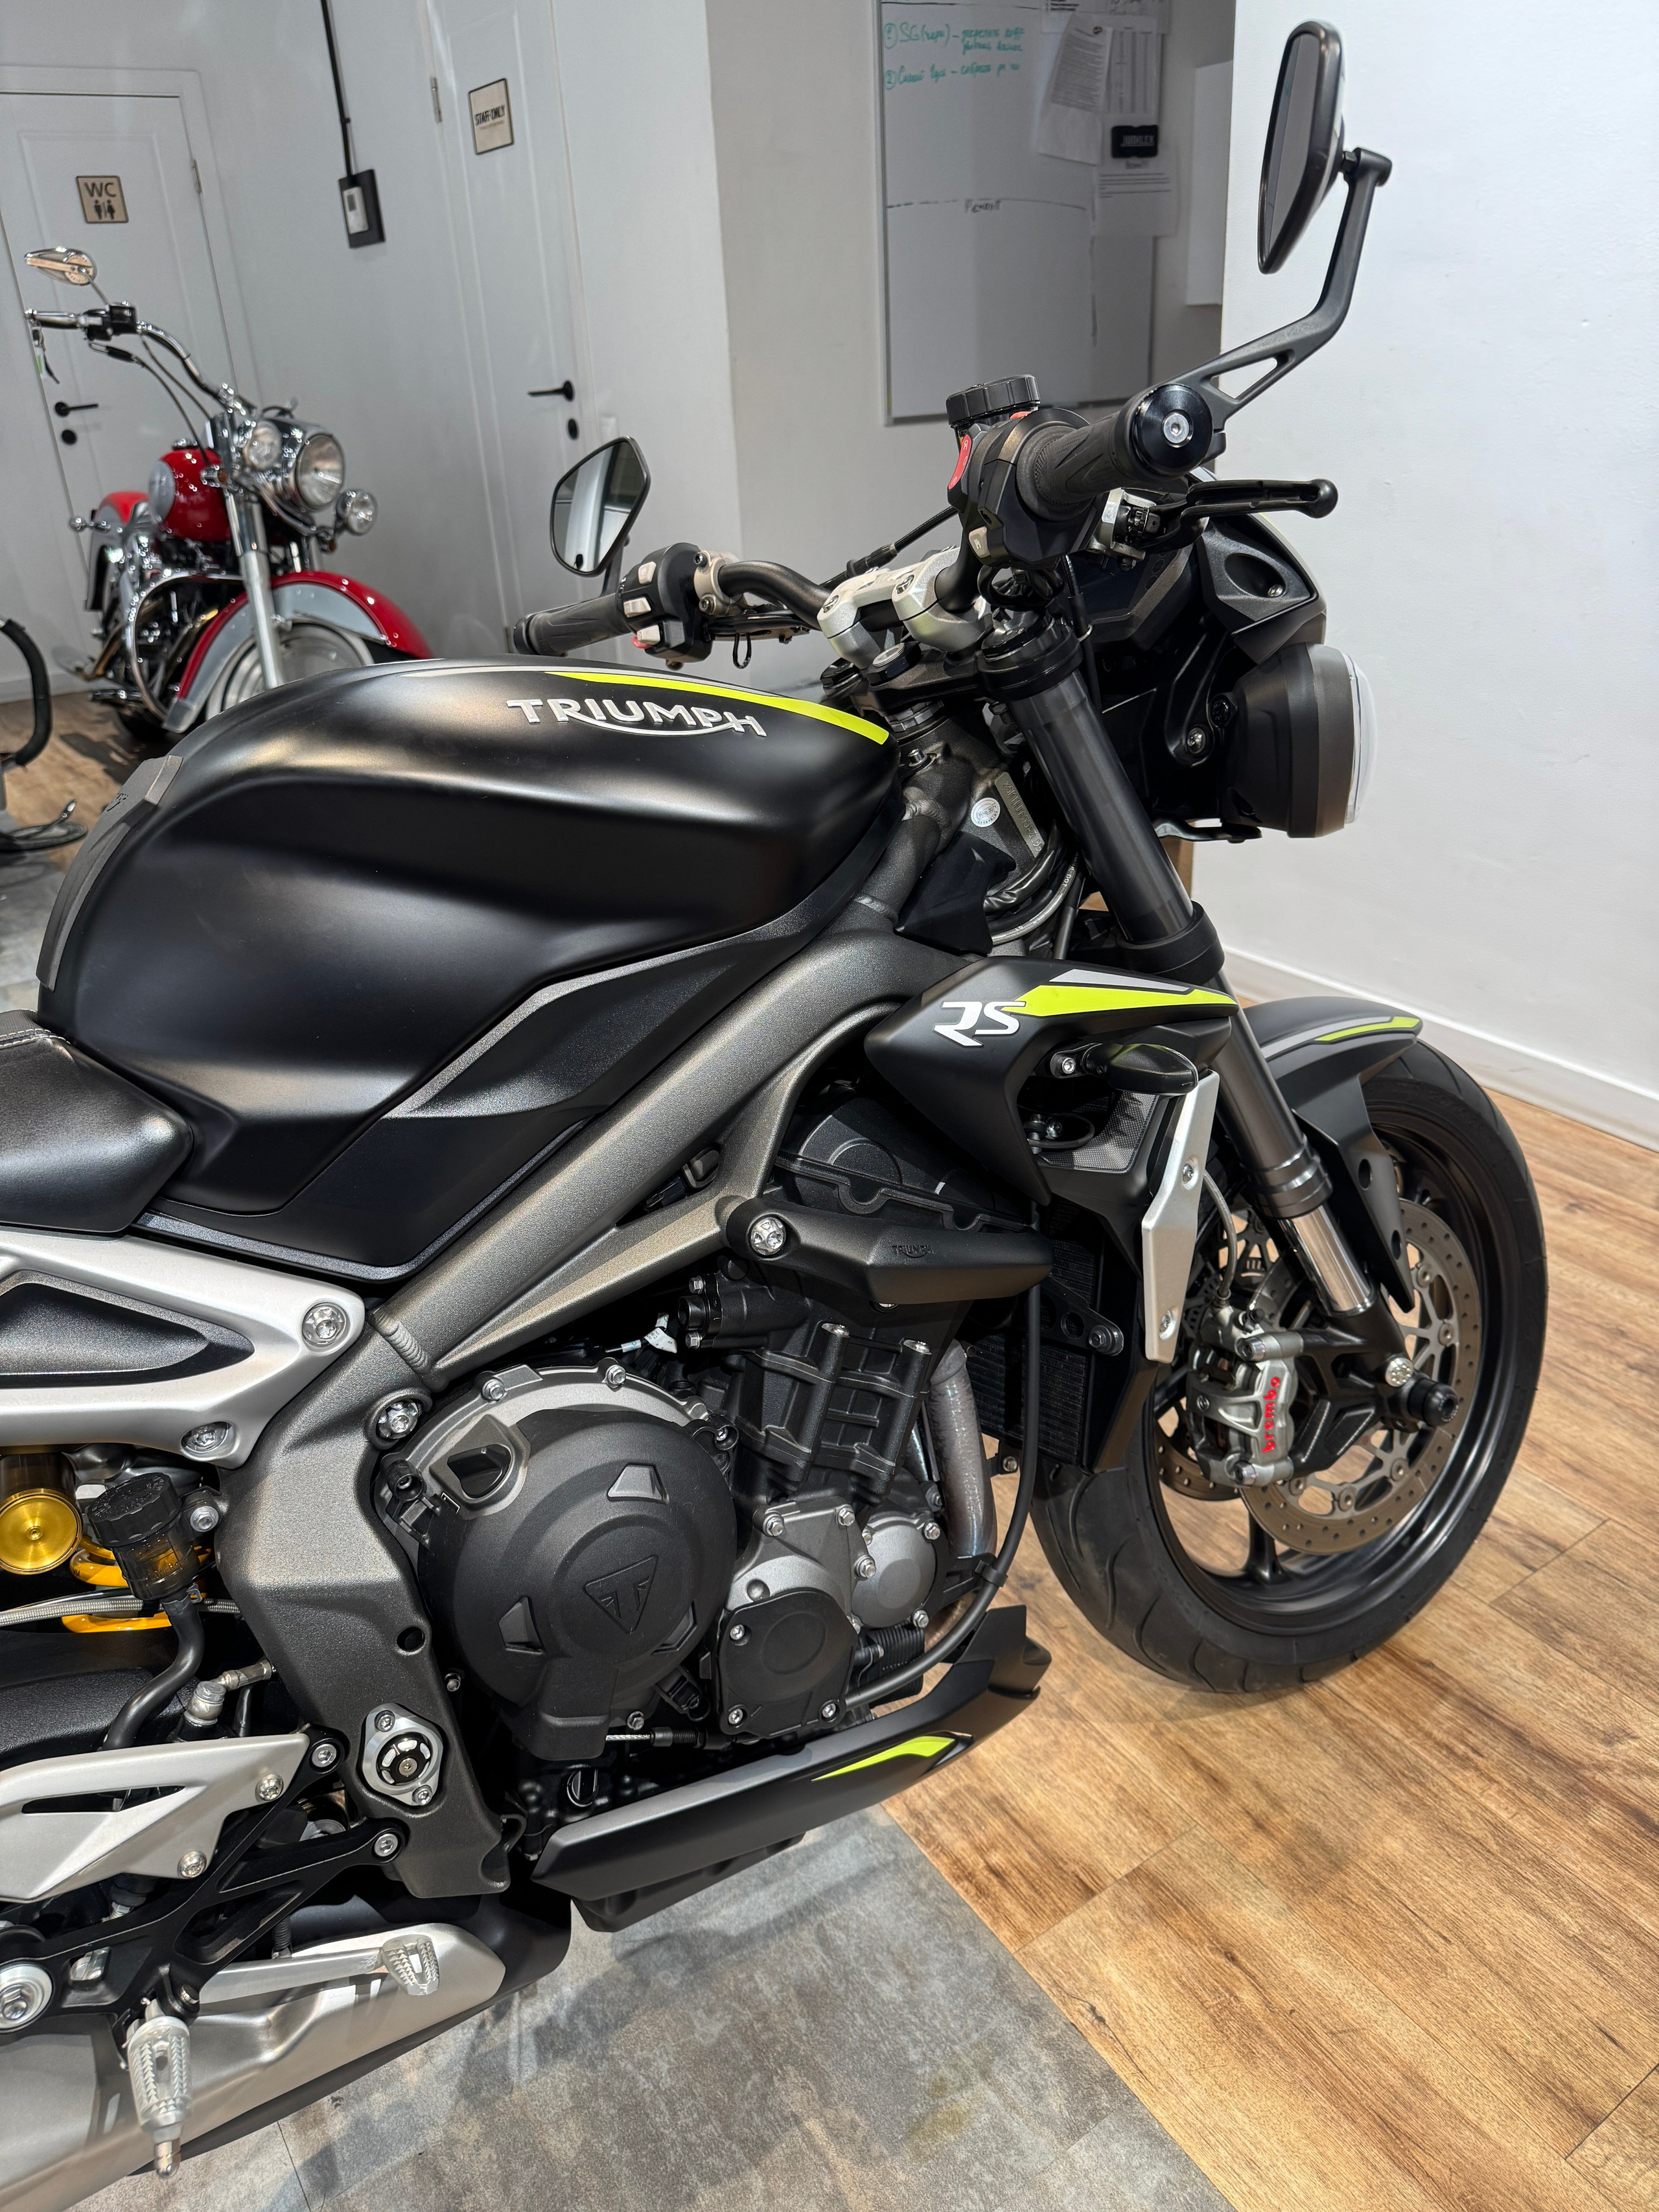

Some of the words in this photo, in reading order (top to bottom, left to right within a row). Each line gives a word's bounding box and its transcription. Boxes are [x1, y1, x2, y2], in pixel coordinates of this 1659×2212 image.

[84, 181, 117, 198] WC
[506, 699, 767, 737] TRIUMPH
[933, 1001, 1027, 1047] RS
[1261, 1376, 1281, 1454] brembo
